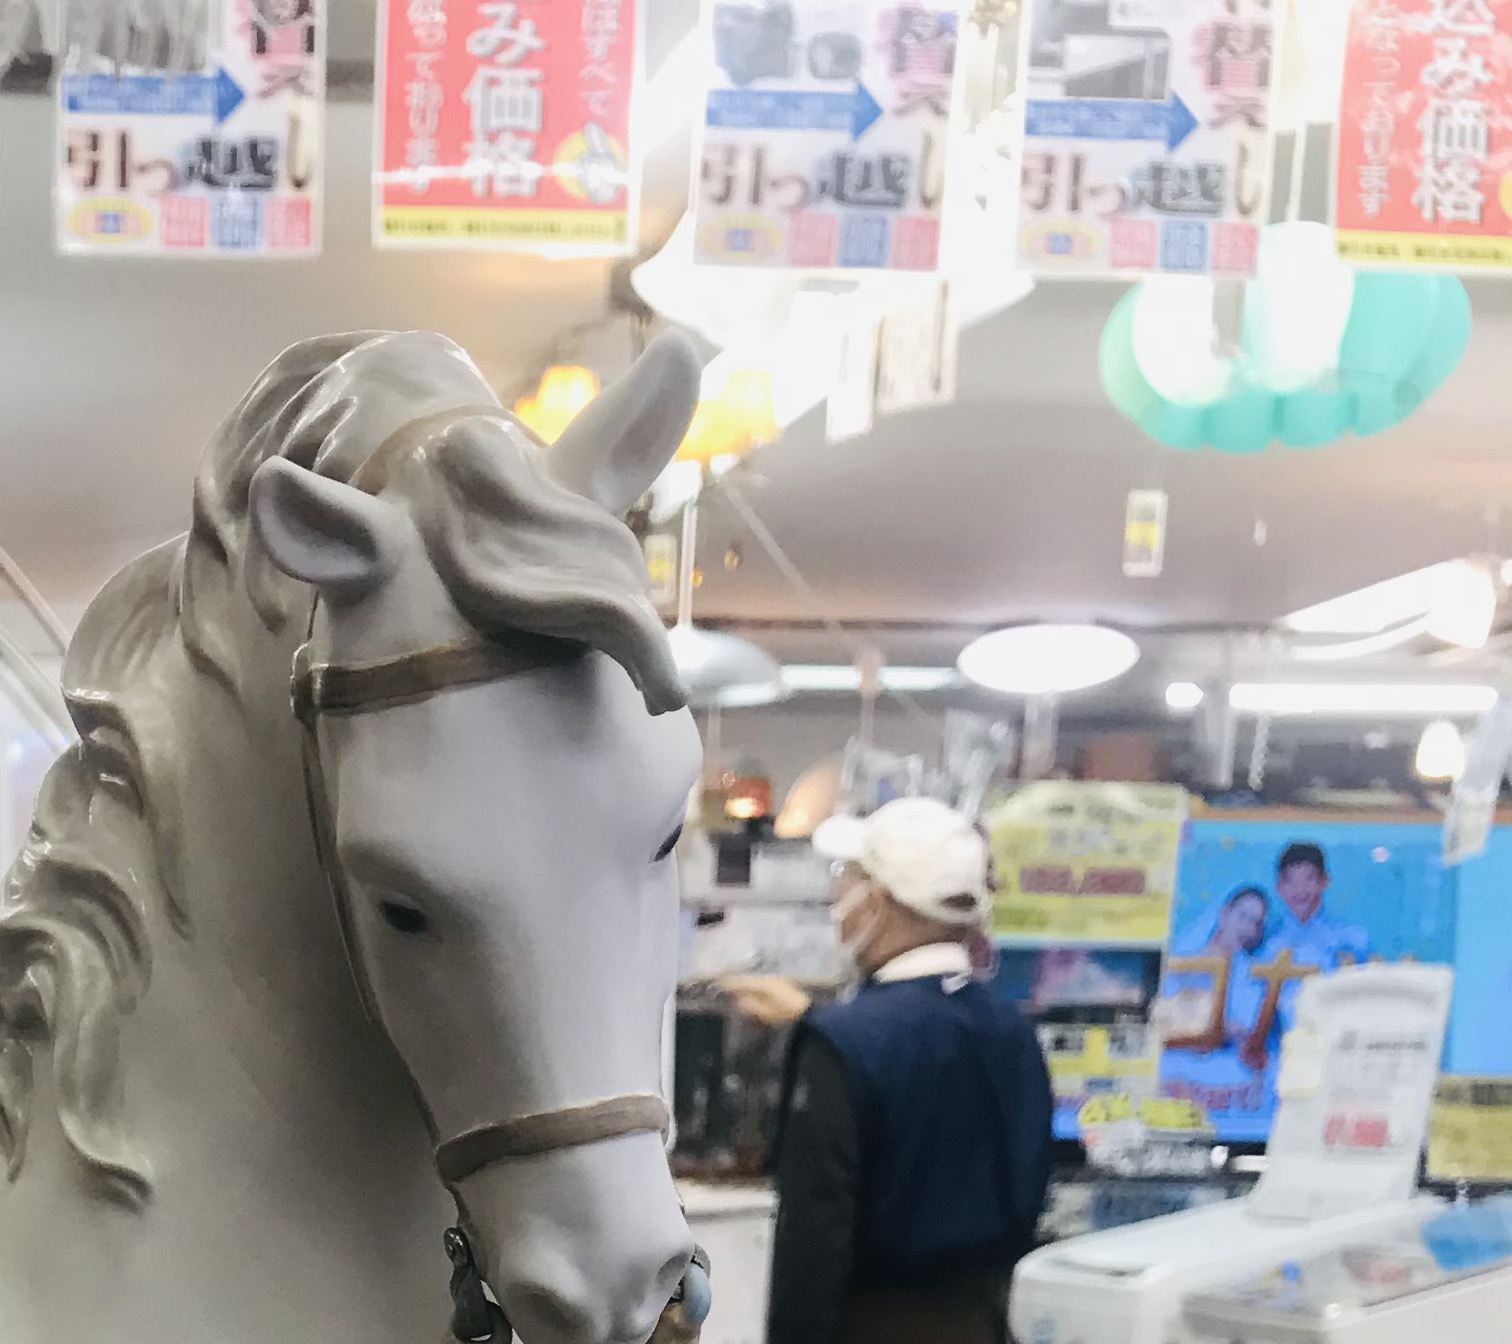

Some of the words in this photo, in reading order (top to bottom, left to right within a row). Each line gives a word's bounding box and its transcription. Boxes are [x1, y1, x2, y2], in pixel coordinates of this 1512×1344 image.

[66, 113, 310, 194] 引っ越し
[699, 130, 944, 211] 引っ越し
[1019, 143, 1261, 220] 引っ越し
